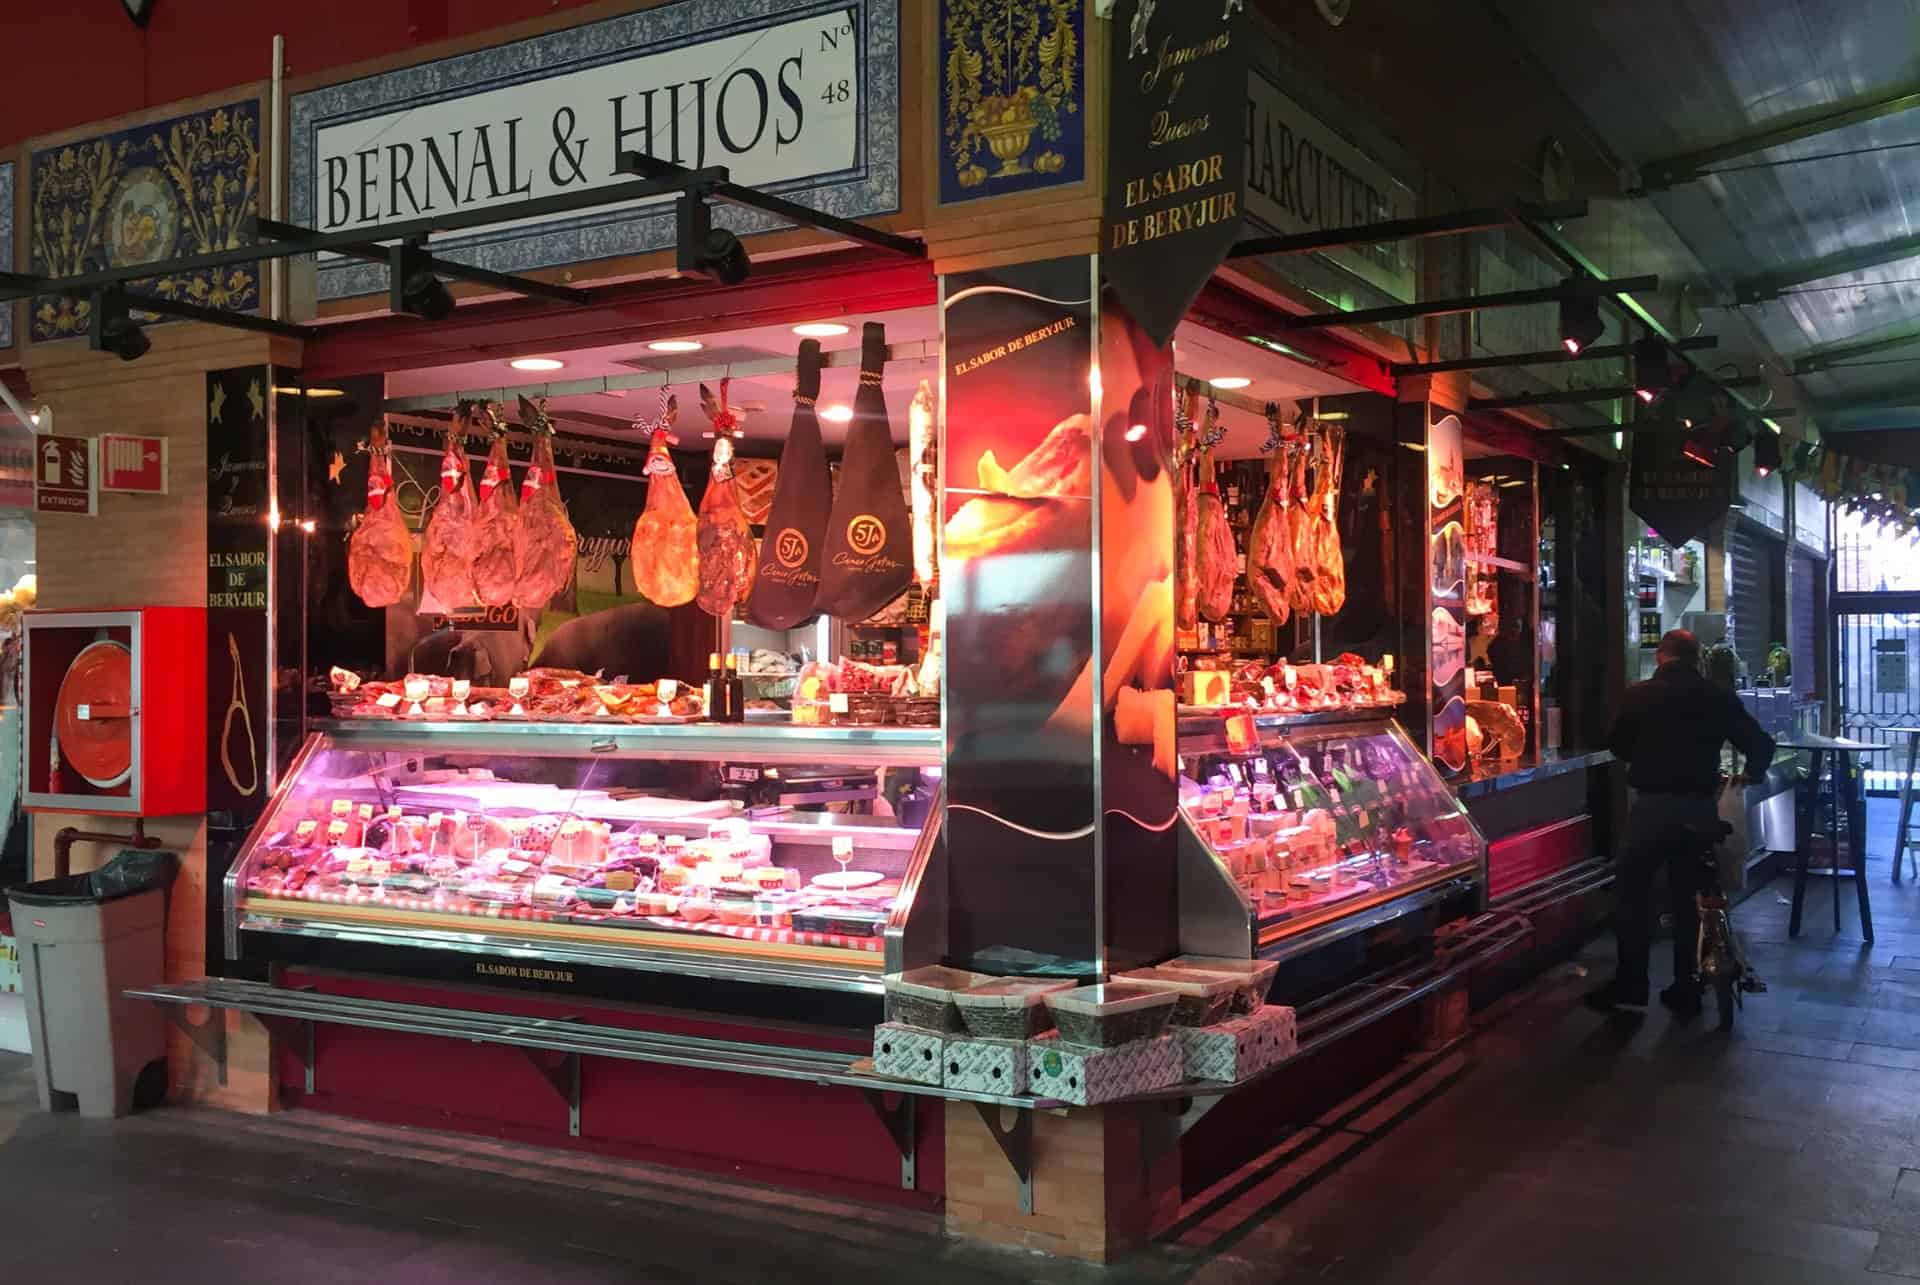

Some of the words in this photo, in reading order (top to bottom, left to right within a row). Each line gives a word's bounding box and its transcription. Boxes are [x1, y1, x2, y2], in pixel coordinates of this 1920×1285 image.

[820, 79, 850, 105] 48
[323, 117, 532, 228] BERNAL
[549, 106, 589, 186] &
[608, 47, 803, 176] HIJOS
[1151, 154, 1223, 199] SABOR
[1112, 219, 1138, 249] DE
[1143, 191, 1236, 240] BERYJUR
[1008, 338, 1024, 353] DE
[1025, 317, 1076, 346] BERYJUR
[225, 552, 265, 567] SABOR
[229, 572, 246, 586] DE
[209, 591, 265, 608] BERYJUR
